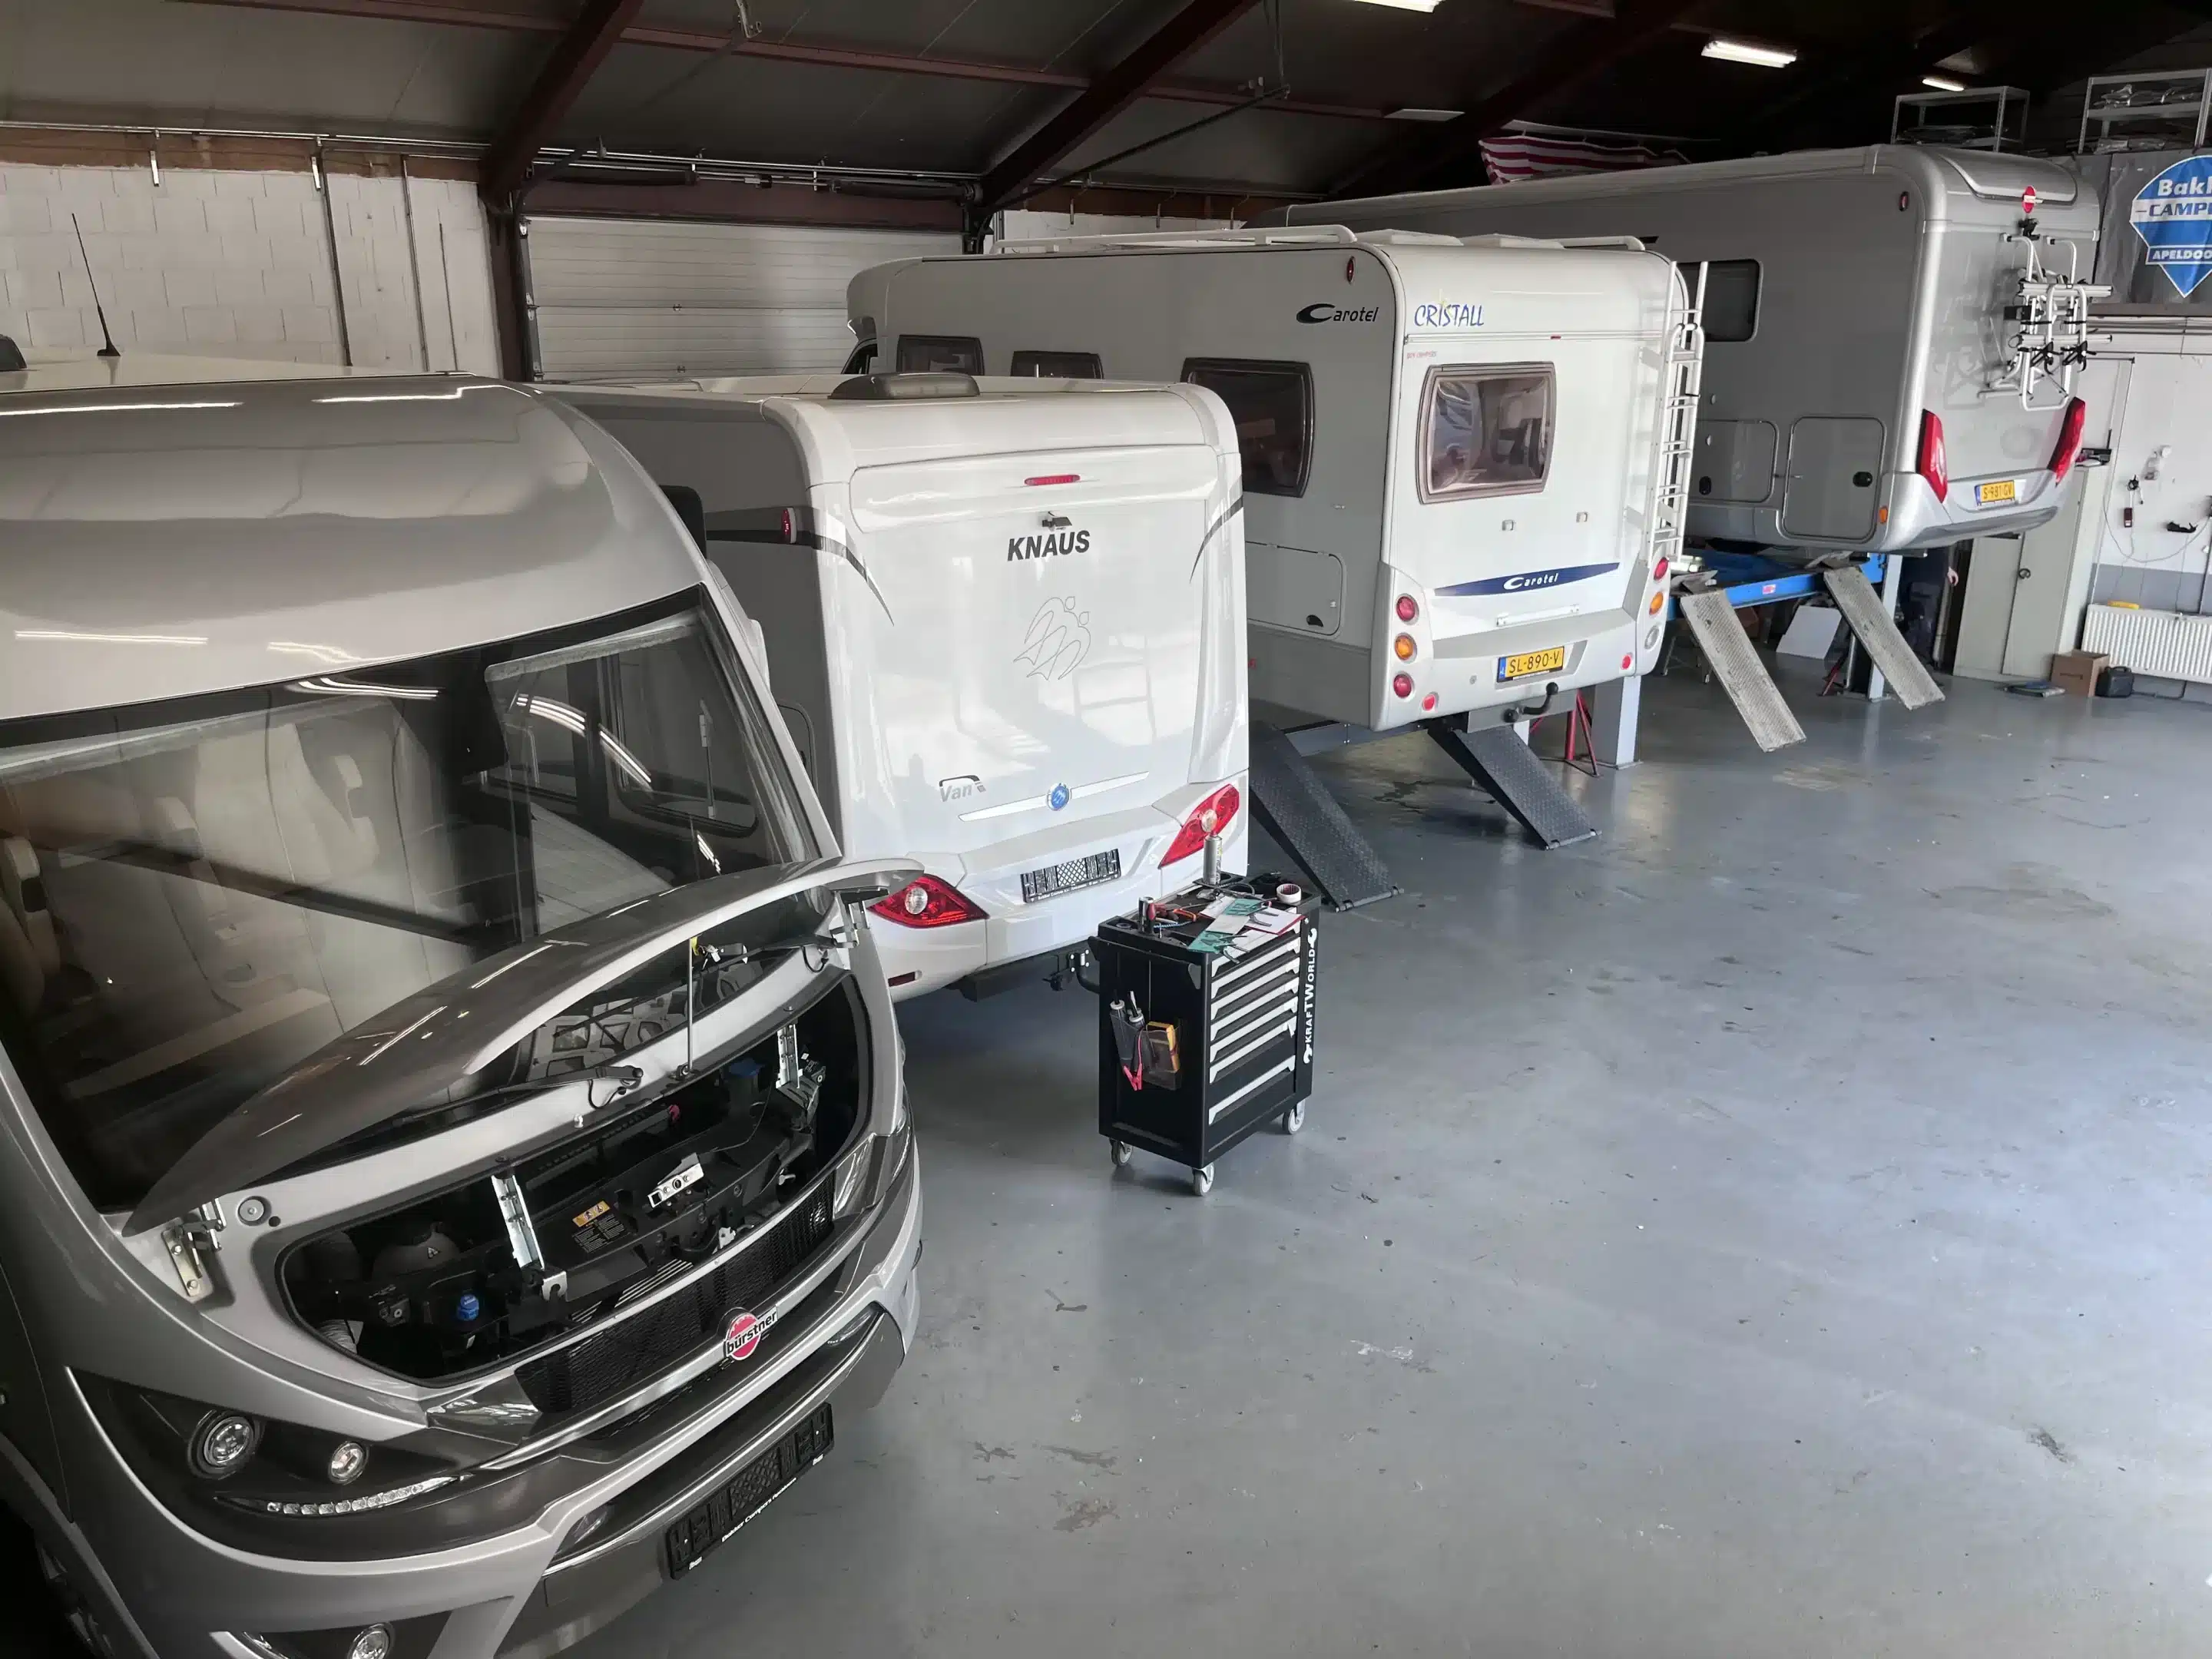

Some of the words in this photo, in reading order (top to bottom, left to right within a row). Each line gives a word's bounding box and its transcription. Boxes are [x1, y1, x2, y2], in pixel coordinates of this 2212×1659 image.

[1296, 303, 1379, 324] Carotel
[1414, 303, 1485, 327] CRISTALL
[1007, 530, 1091, 561] KNAUS
[1503, 572, 1559, 591] Carotel
[1509, 651, 1560, 674] SL-890-V
[727, 1311, 777, 1354] bürstner
